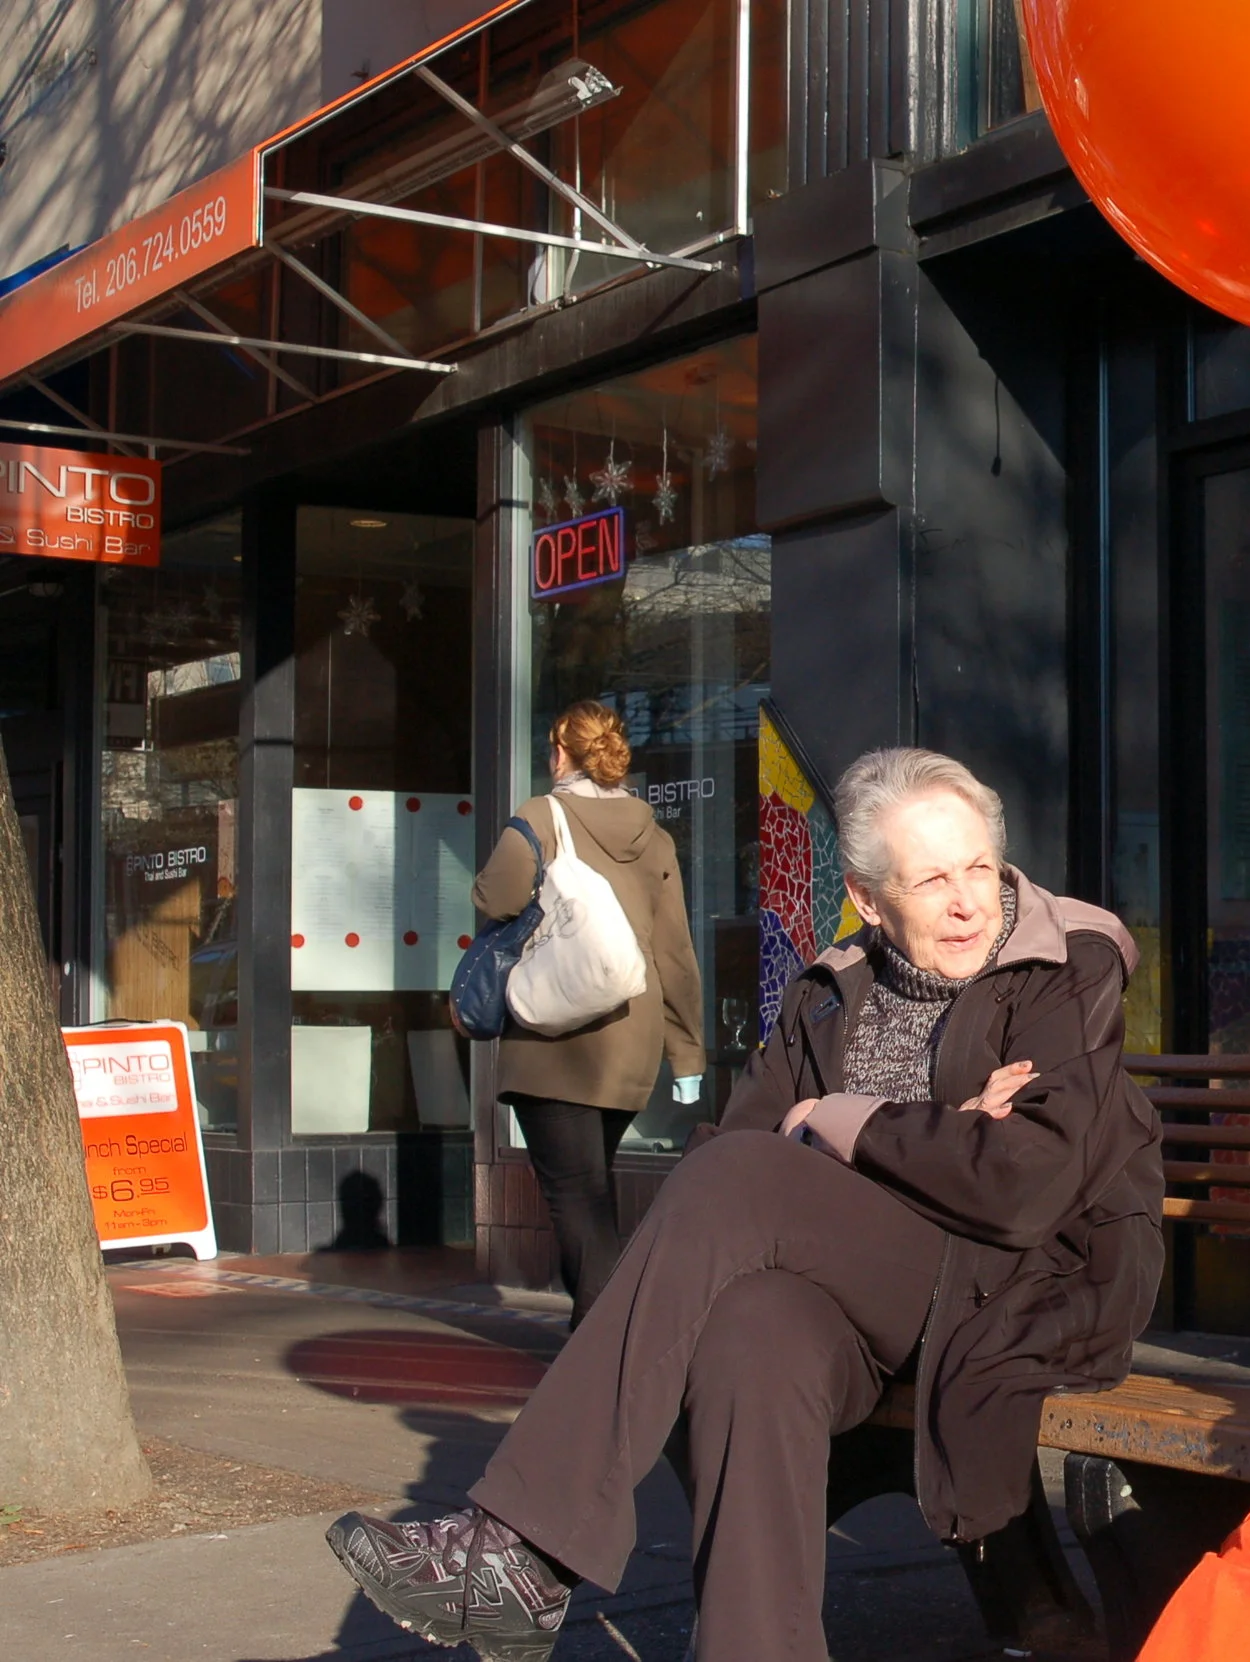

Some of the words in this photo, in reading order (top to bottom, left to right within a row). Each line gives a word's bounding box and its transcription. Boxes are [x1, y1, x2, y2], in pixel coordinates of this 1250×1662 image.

[75, 268, 100, 313] Tel.
[105, 196, 226, 297] 206.724.0559
[0, 460, 155, 506] INTO
[66, 505, 154, 529] BISTRO
[27, 528, 93, 551] Sushi
[105, 535, 151, 556] Bar
[535, 514, 619, 590] OPEN
[648, 777, 715, 804] BISTRO
[666, 806, 682, 819] Bar
[167, 846, 206, 867] BISTRO
[82, 1054, 170, 1074] PINTO
[113, 1073, 171, 1086] BISTRO
[96, 1096, 108, 1108] &
[110, 1094, 148, 1107] Sushi
[125, 1132, 188, 1158] Special
[113, 1166, 147, 1176] from
